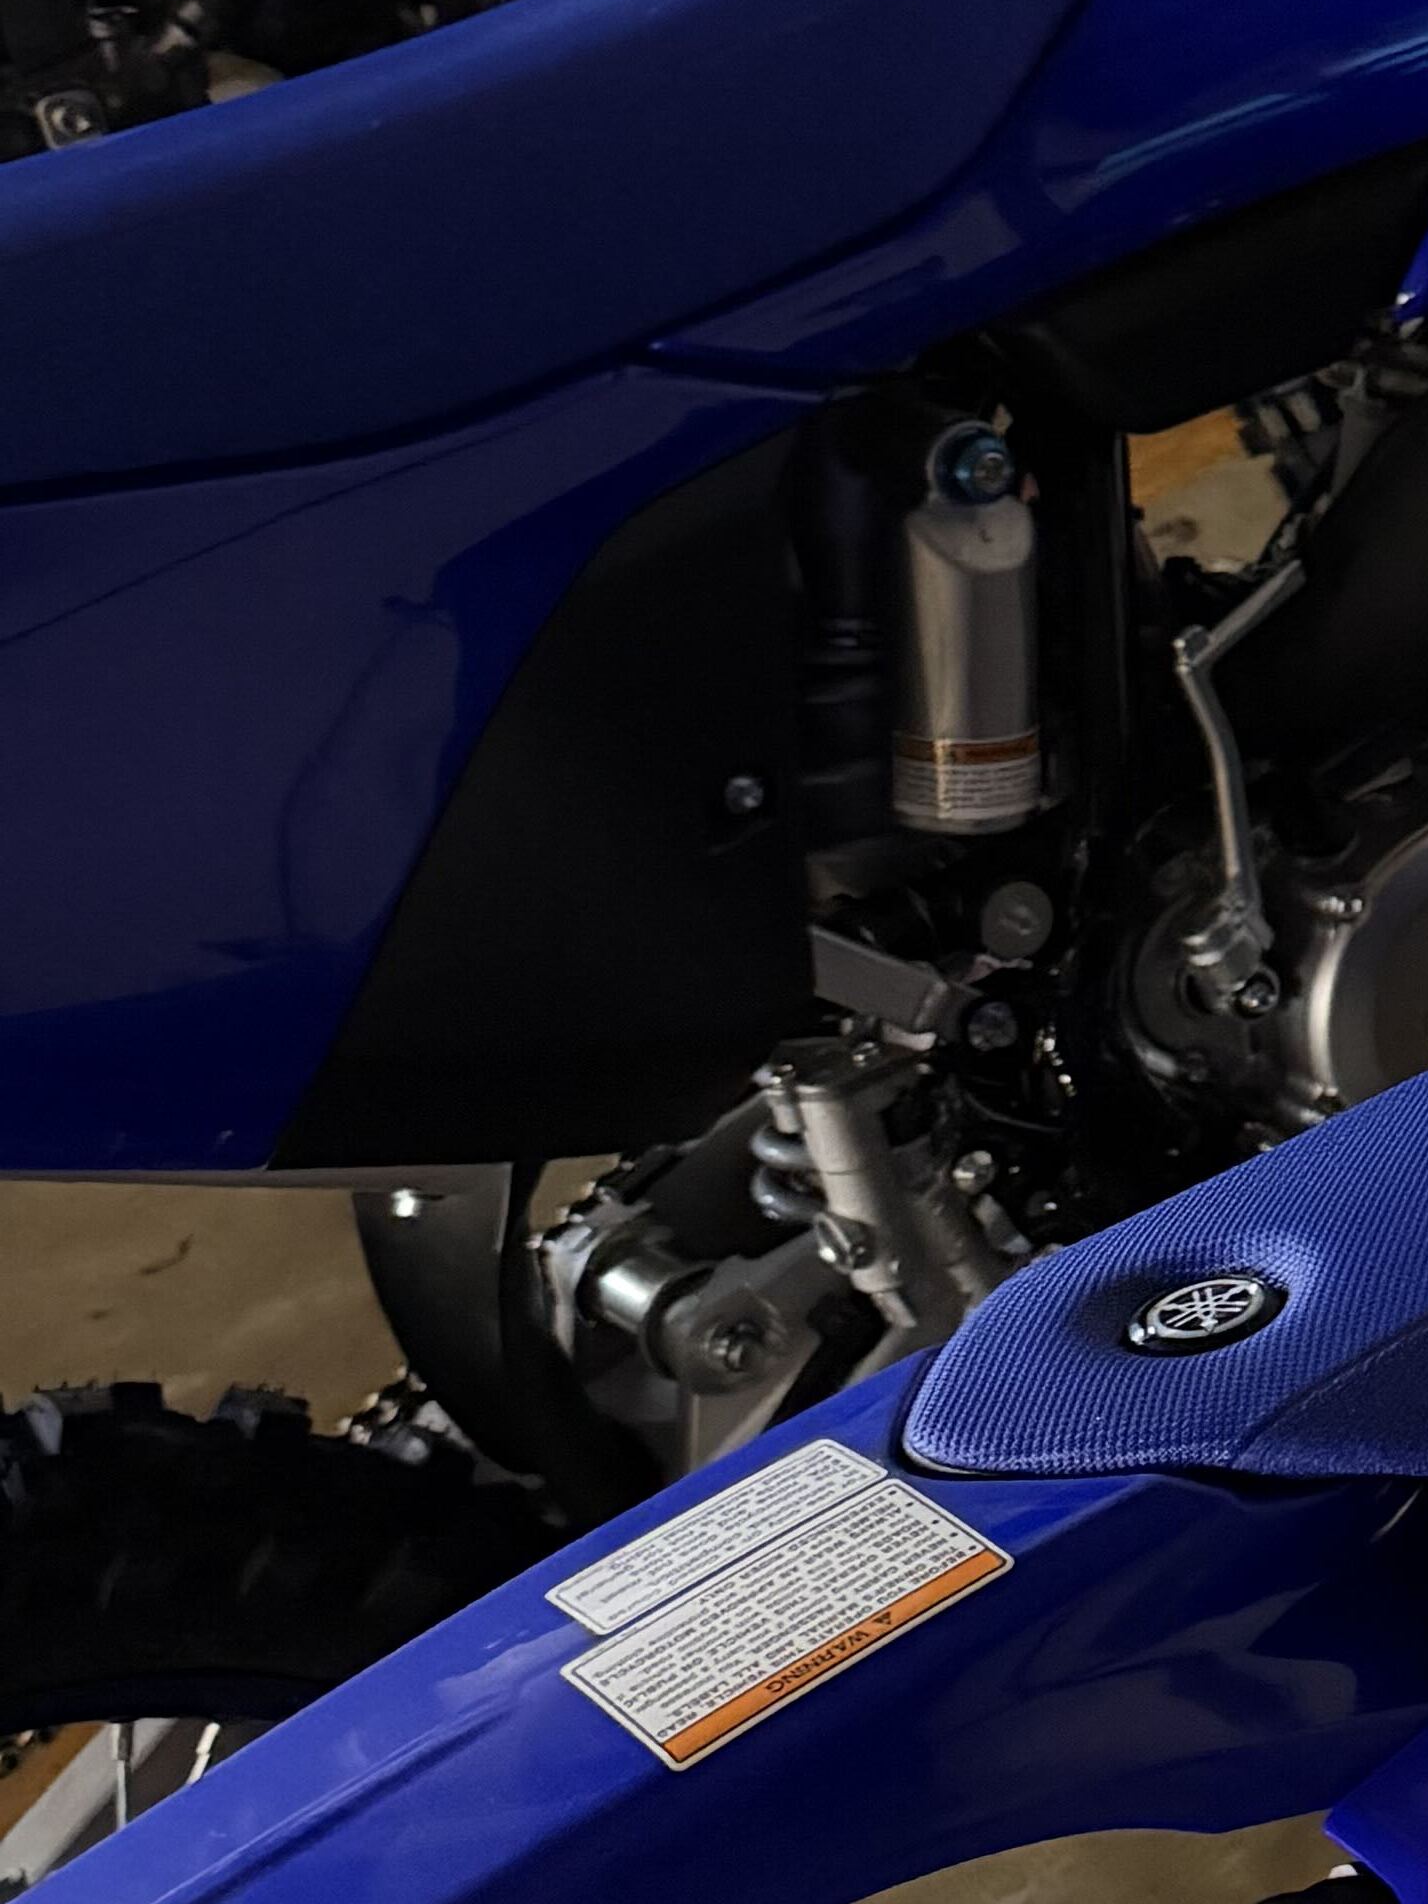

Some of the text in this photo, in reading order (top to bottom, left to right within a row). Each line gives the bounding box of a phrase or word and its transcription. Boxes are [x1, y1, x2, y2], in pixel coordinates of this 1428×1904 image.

[786, 1494, 886, 1553] EXPERIENCED
[848, 1506, 904, 1540] ALWAYS
[866, 1518, 922, 1551] ROADS.
[879, 1524, 931, 1555] NEVER
[738, 1551, 785, 1581] RIDER
[802, 1538, 847, 1565] WEAR
[899, 1536, 949, 1566] NEVER
[908, 1550, 967, 1585] BEFORE
[927, 1544, 959, 1564] THE
[810, 1552, 880, 1594] OPERATE
[851, 1564, 900, 1595] CARRY
[697, 1579, 777, 1627] APPROVED
[772, 1593, 809, 1617] THIS
[874, 1585, 907, 1605] YOU
[706, 1615, 771, 1656] VEHICLE
[745, 1602, 835, 1658] PASSENGER.
[797, 1601, 860, 1639] MANUAL
[806, 1604, 875, 1646] OPERATE
[598, 1626, 697, 1687] MOTORCYCLE
[762, 1627, 871, 1695] WARNING
[763, 1638, 797, 1661] AND
[769, 1645, 805, 1668] THIS
[730, 1659, 762, 1680] ALL
[622, 1671, 679, 1708] PUBLIC
[665, 1679, 730, 1720] LABELS.
[654, 1709, 699, 1739] READ
